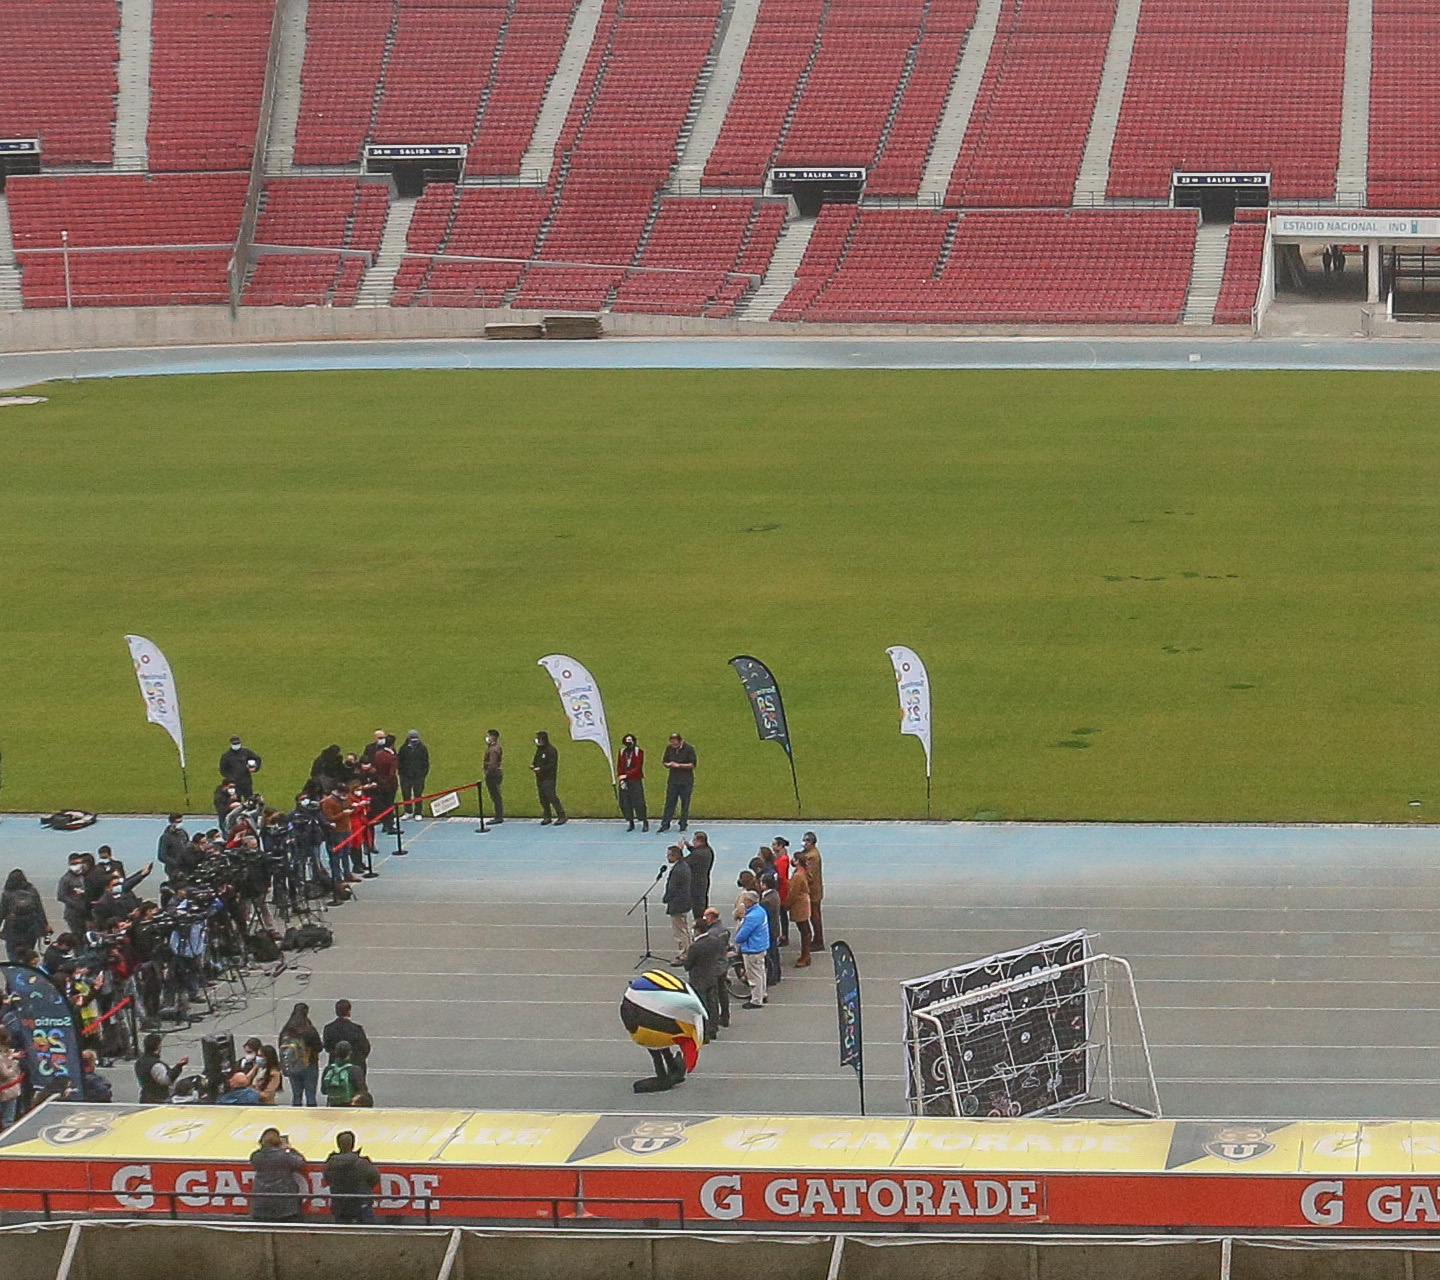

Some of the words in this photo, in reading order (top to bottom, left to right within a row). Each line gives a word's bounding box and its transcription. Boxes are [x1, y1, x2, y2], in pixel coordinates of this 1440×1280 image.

[1282, 220, 1325, 231] ESTADIO
[1327, 221, 1378, 231] NACIONAL
[1389, 222, 1408, 232] IND
[808, 1131, 1135, 1153] GATORADE
[700, 1175, 744, 1221] G
[764, 1177, 1038, 1217] GATORADE
[1300, 1180, 1344, 1226] G
